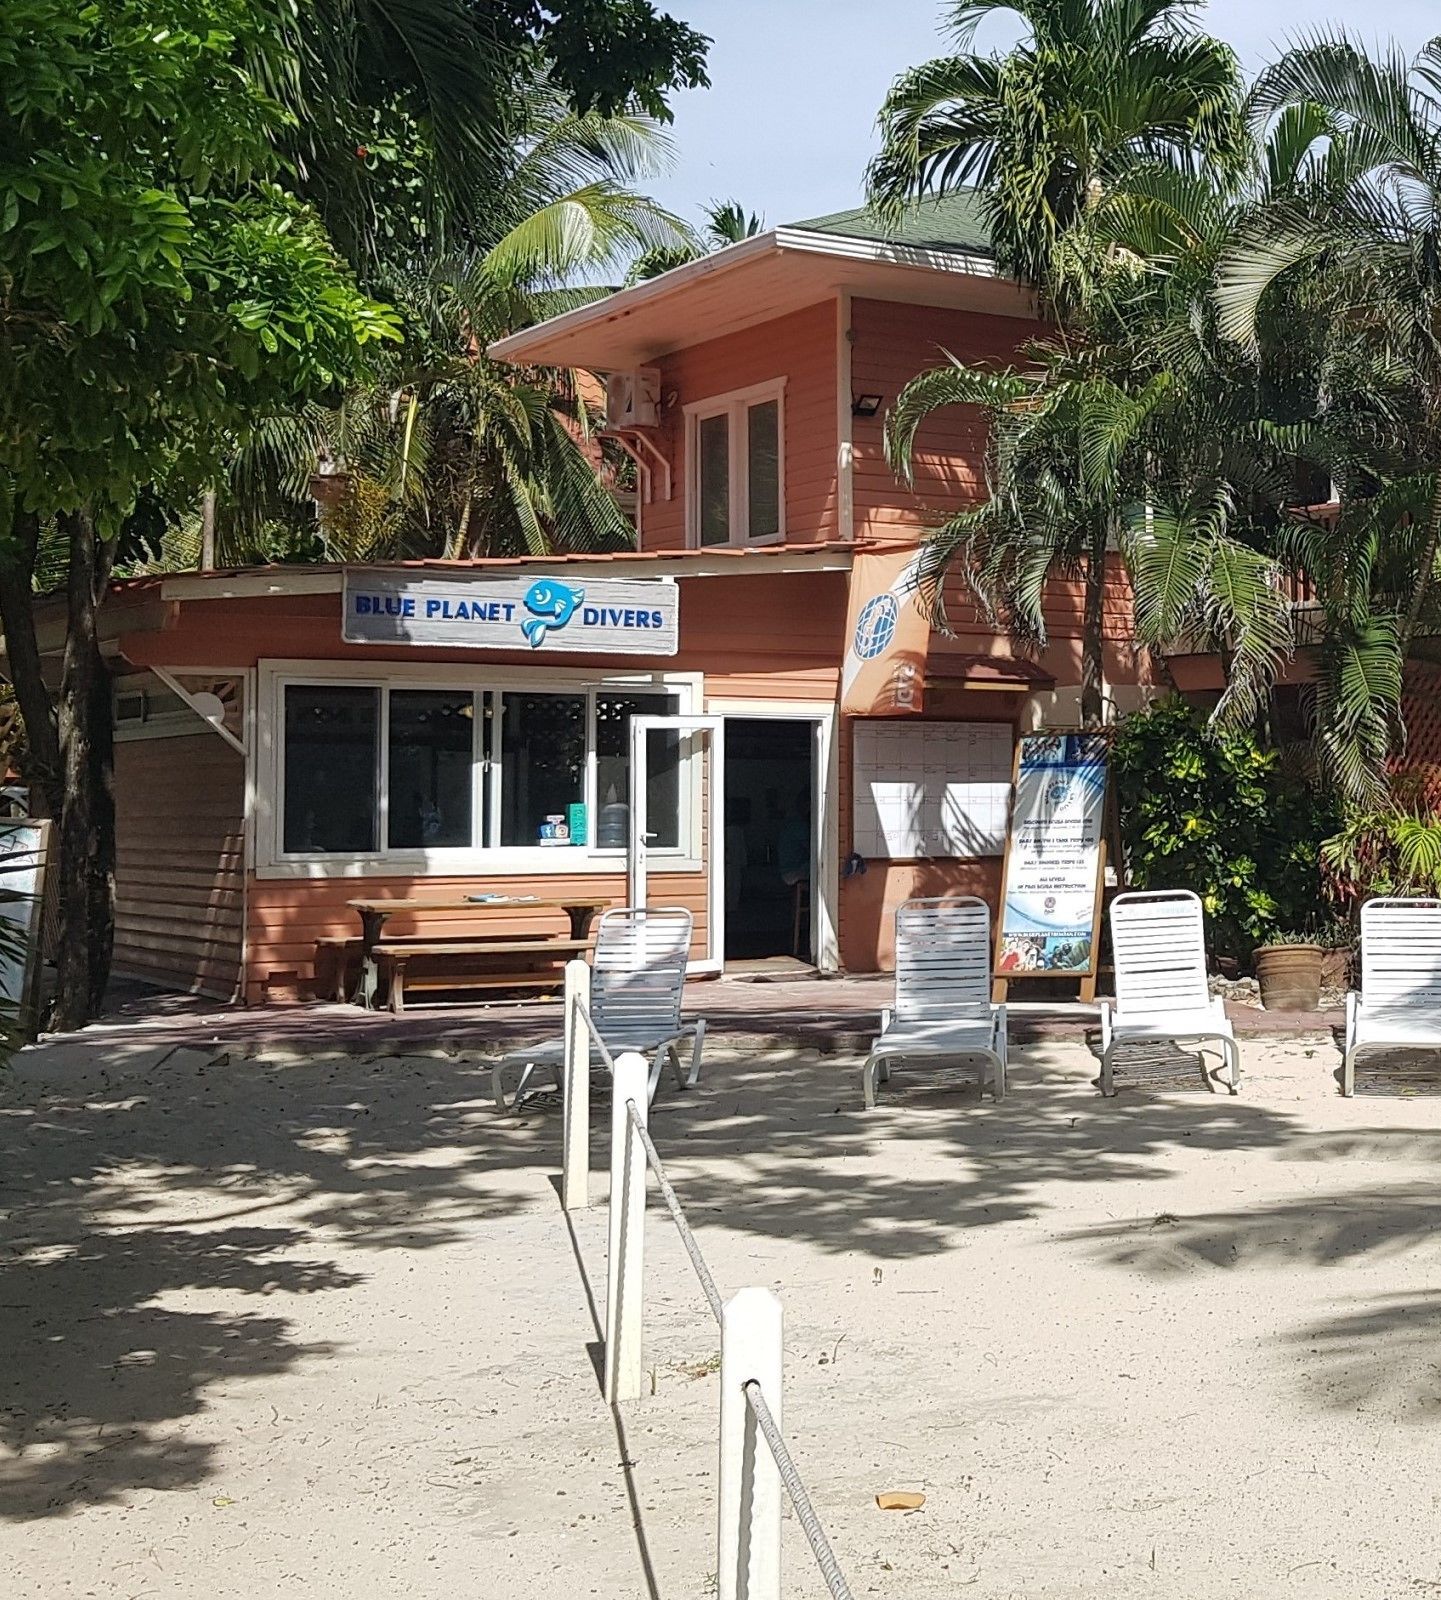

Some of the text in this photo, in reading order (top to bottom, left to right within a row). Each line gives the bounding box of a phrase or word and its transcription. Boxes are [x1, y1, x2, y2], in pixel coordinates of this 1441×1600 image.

[355, 595, 663, 629] BLUE PLANET DIVERS
